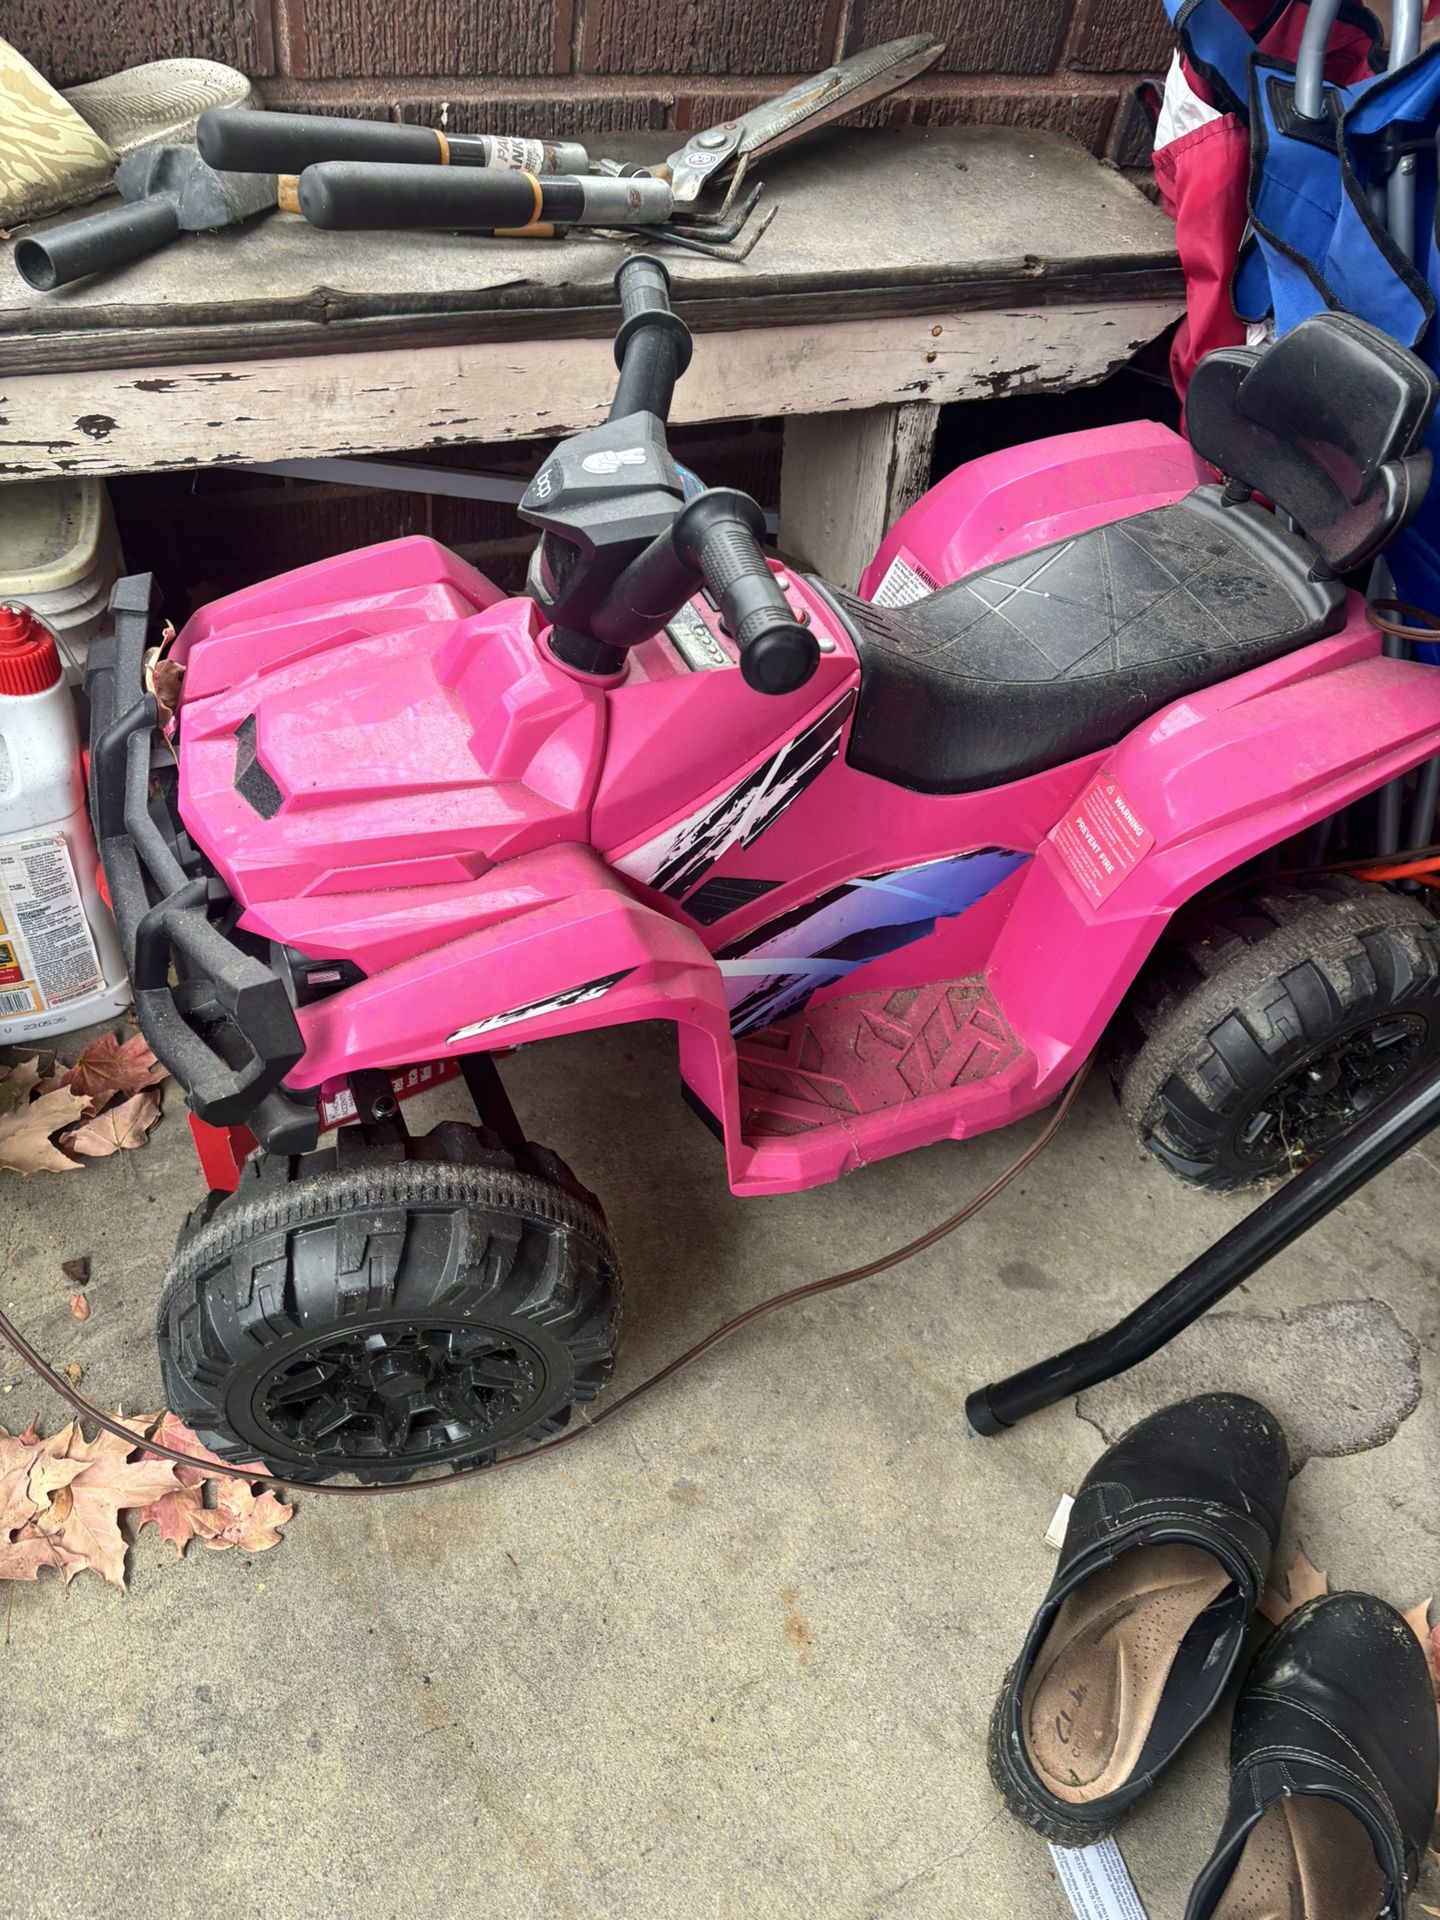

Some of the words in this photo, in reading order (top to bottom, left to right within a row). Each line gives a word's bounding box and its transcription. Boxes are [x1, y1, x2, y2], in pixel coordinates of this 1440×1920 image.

[1075, 816, 1102, 853] PREVENT
[1097, 853, 1116, 875] FIRE
[1114, 796, 1144, 837] WARNING
[1056, 1684, 1088, 1745] Clks
